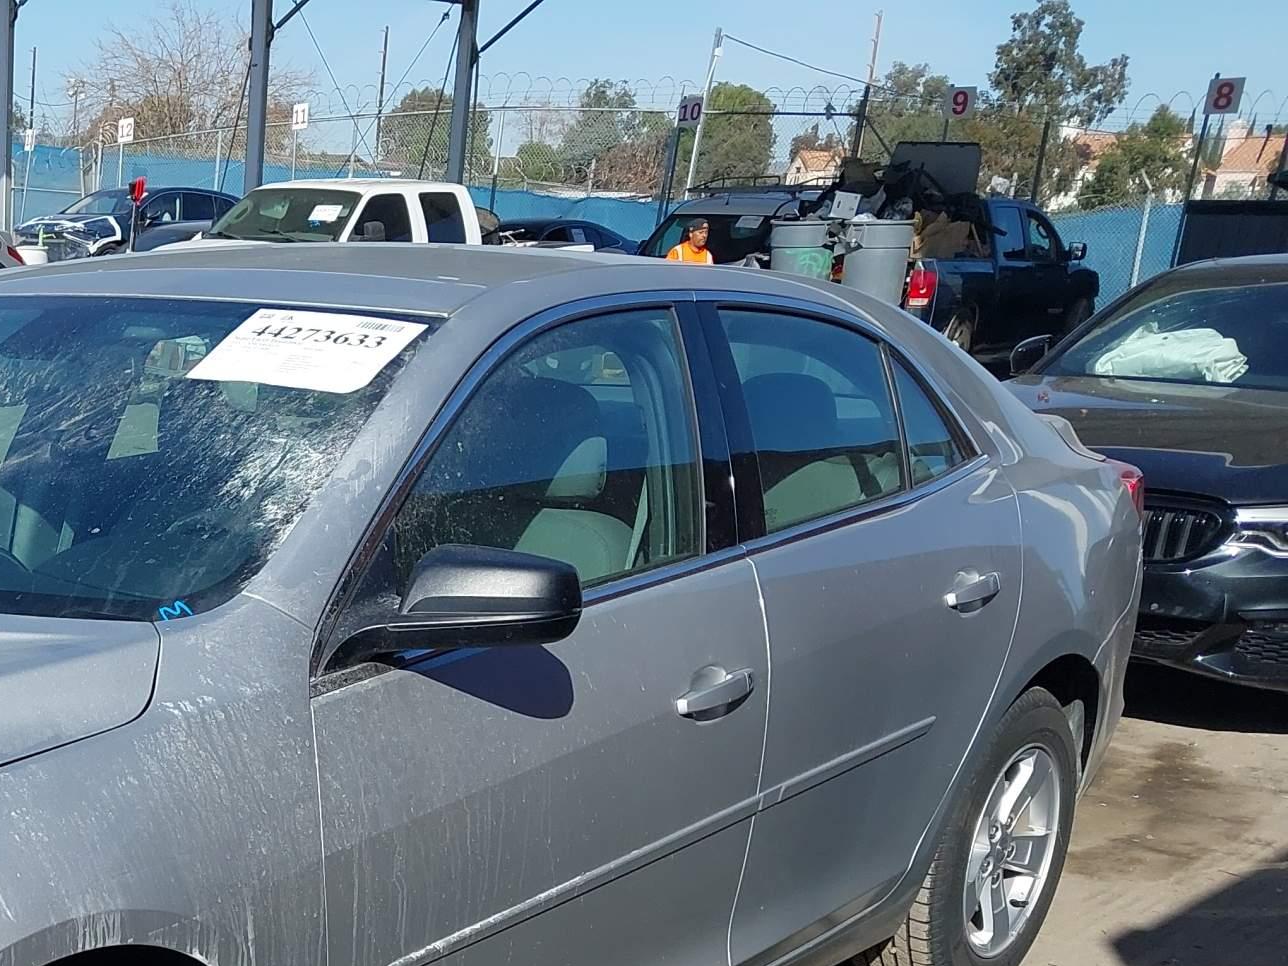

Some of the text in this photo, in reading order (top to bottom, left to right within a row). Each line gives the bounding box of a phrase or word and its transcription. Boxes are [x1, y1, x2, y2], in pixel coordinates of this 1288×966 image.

[952, 91, 968, 115] 9
[1213, 82, 1234, 109] 8
[294, 107, 306, 124] 11
[679, 103, 701, 121] 10
[120, 123, 133, 138] 12
[251, 325, 387, 349] 44273633
